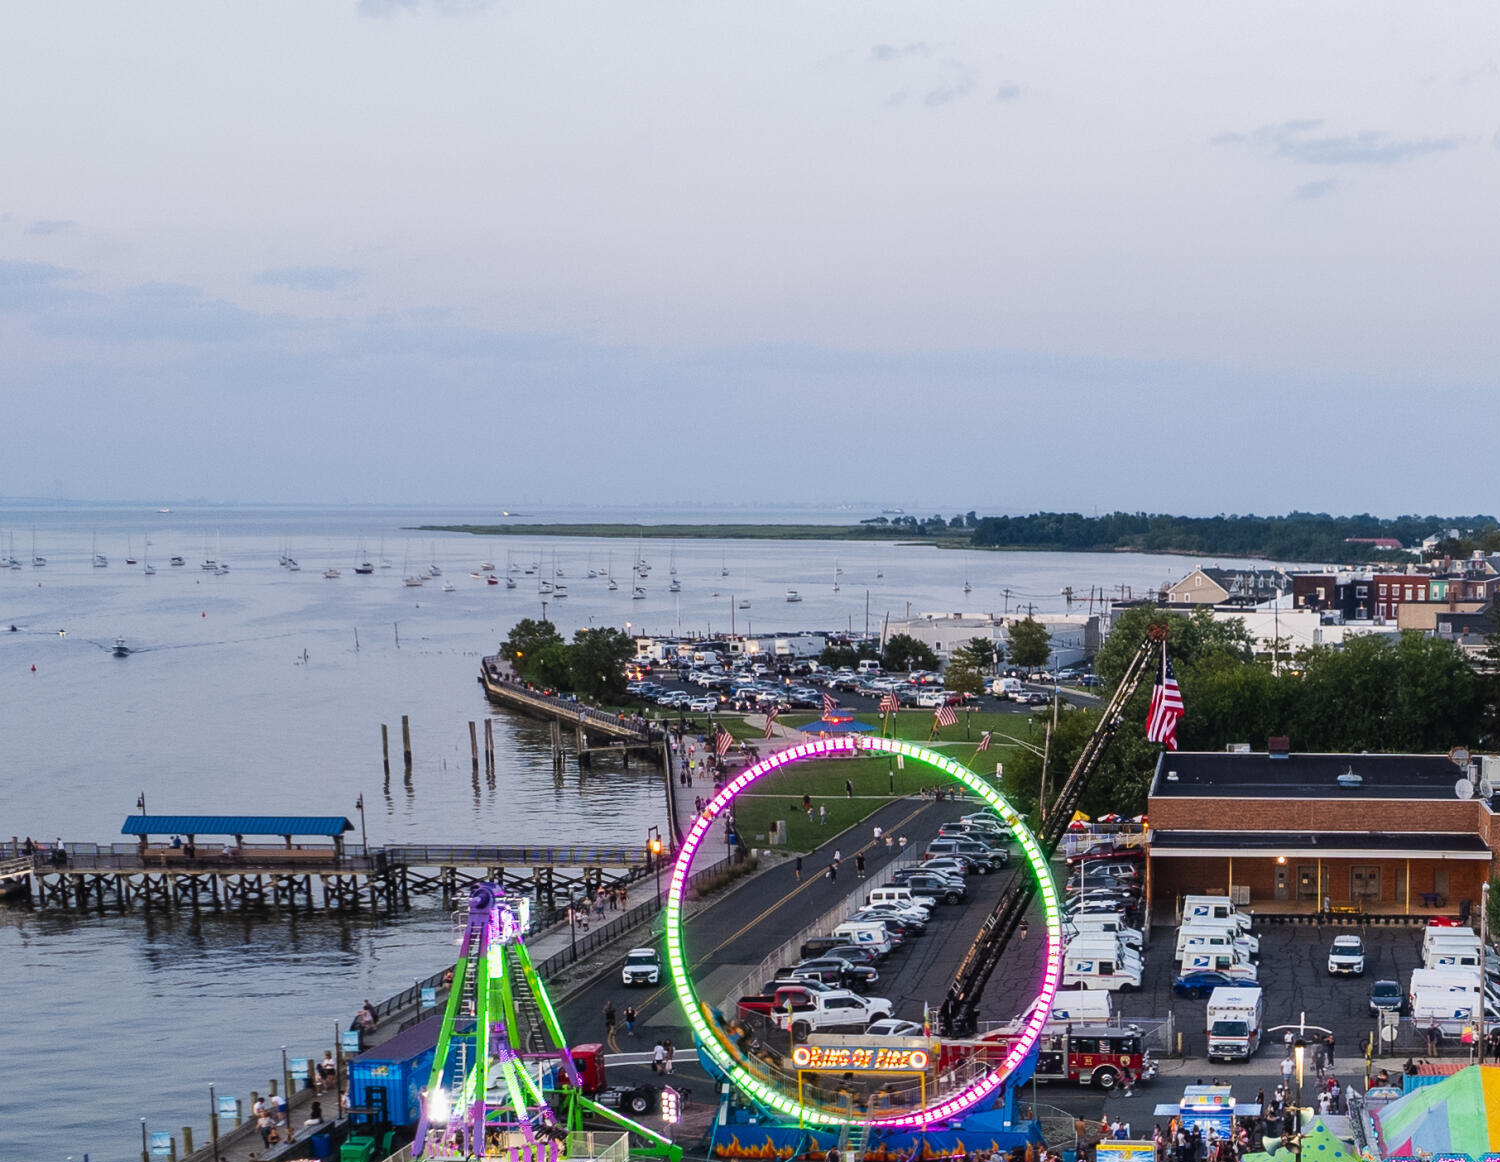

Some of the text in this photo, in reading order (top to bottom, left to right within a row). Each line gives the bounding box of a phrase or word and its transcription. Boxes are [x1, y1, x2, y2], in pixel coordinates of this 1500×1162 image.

[810, 1046, 912, 1069] RING OF FIRE
